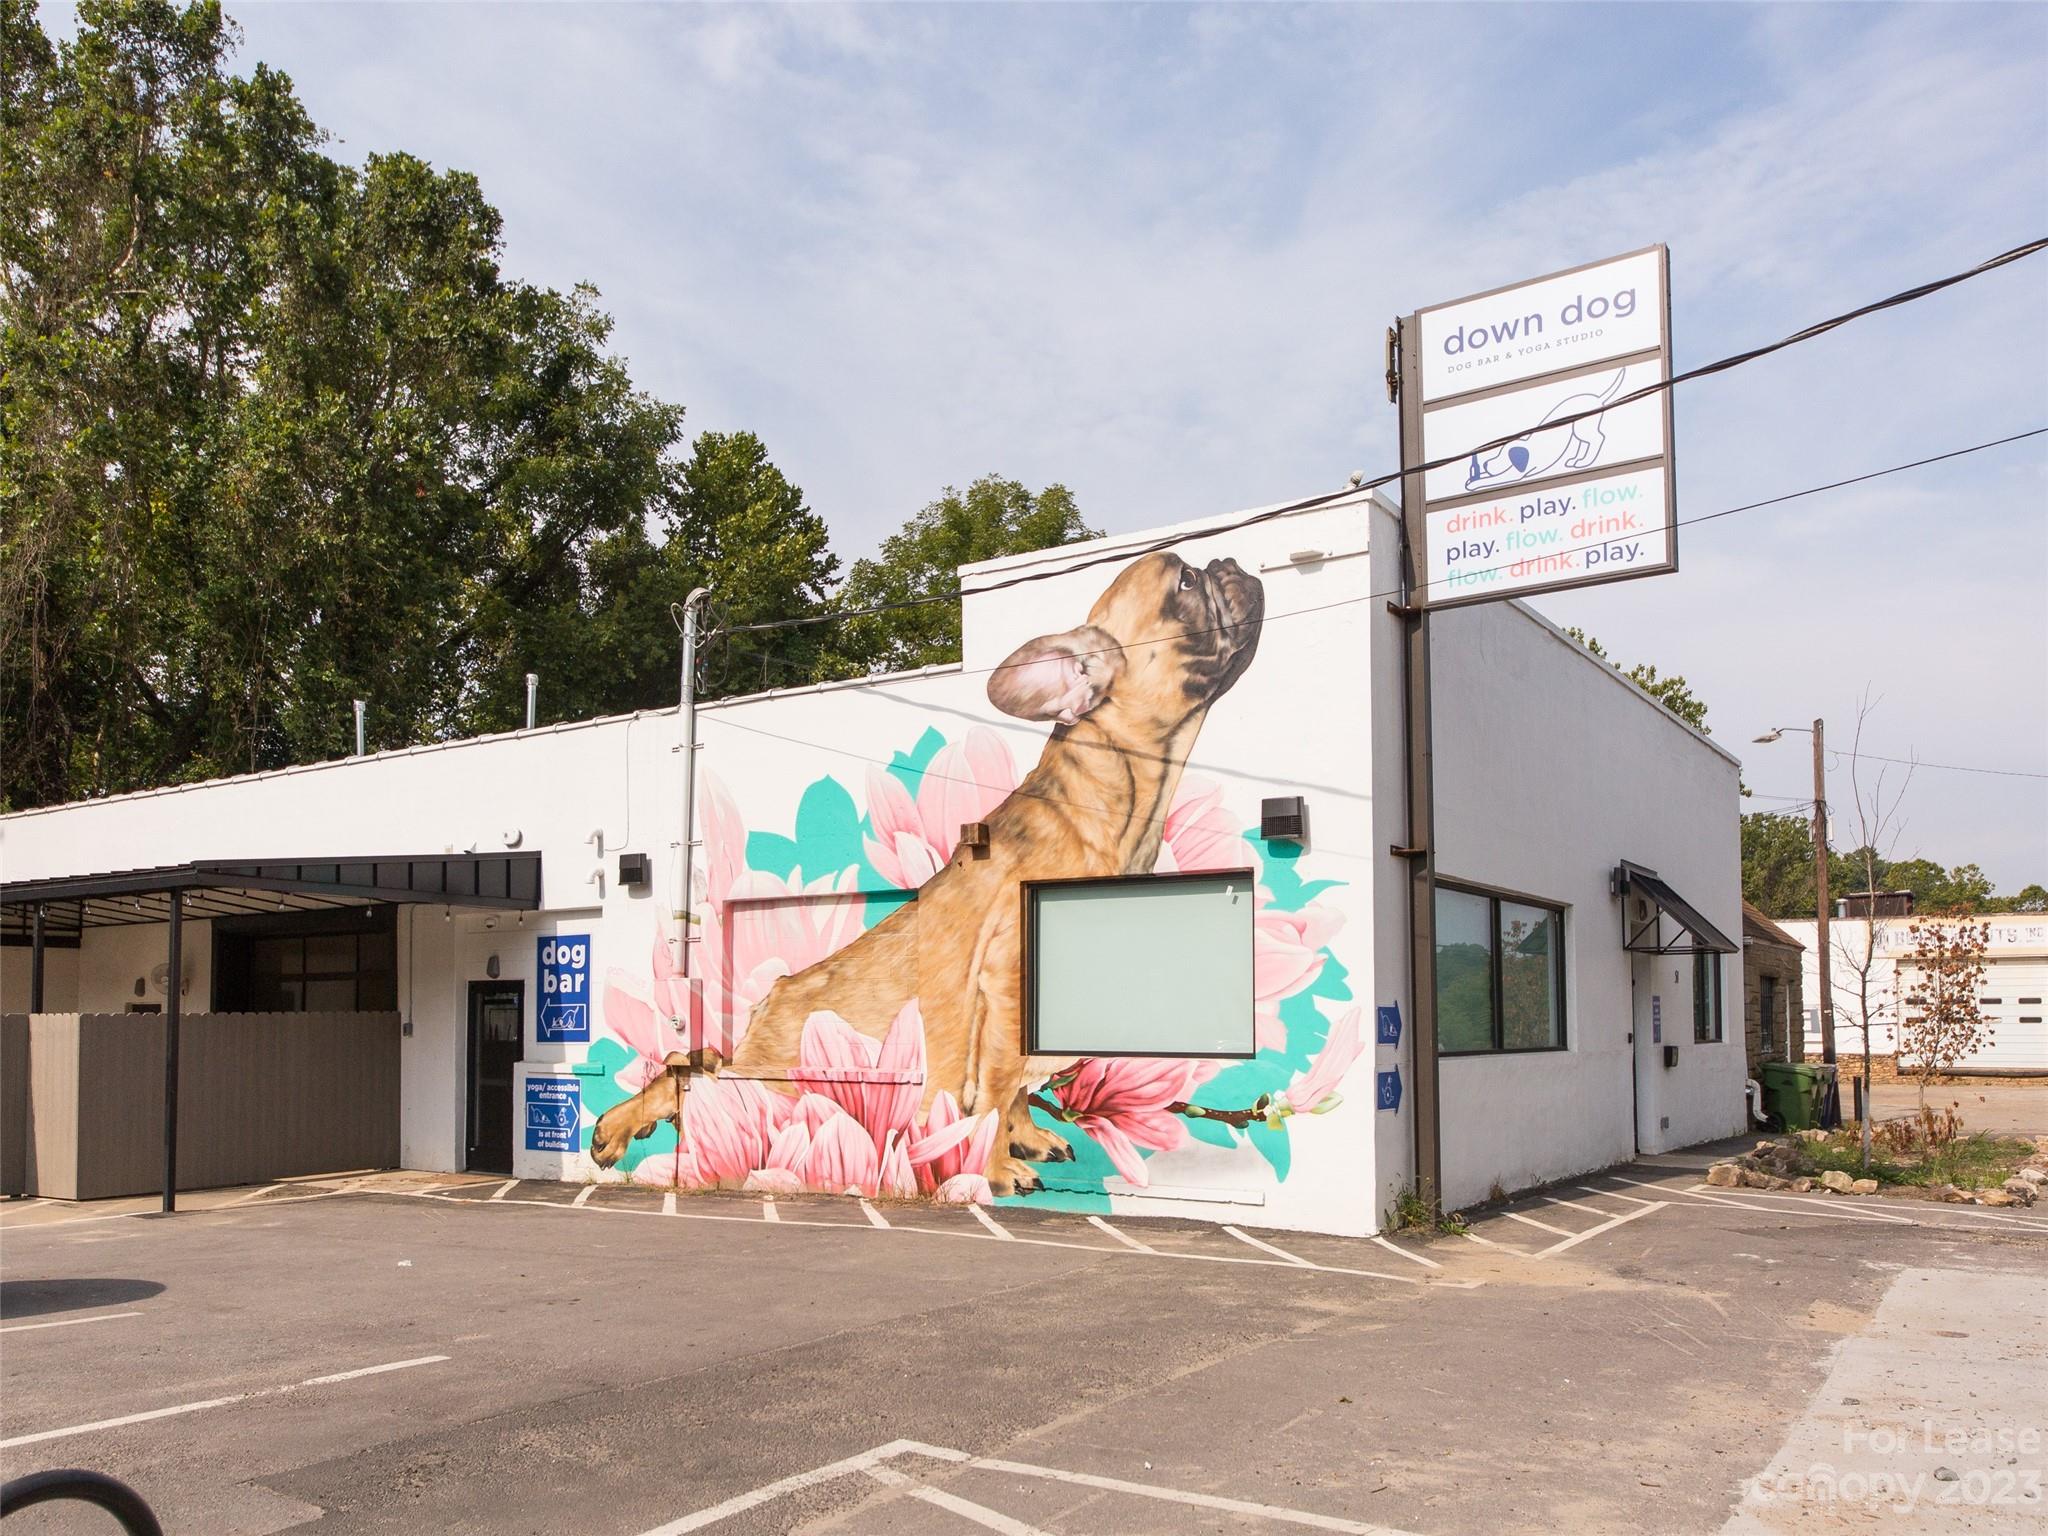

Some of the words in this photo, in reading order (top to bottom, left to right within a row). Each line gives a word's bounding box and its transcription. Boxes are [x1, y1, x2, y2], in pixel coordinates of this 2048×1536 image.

[1444, 313, 1543, 355] down
[1560, 288, 1636, 326] dog
[1447, 361, 1473, 374] DOG
[1478, 355, 1500, 367] BAR
[1505, 351, 1513, 359] &
[1518, 342, 1551, 356] YOGA
[1556, 328, 1604, 347] STUDIO
[1447, 506, 1513, 534] drink.
[1520, 496, 1576, 523] play.
[1582, 484, 1643, 508] flow.
[1447, 539, 1500, 565] play.
[1506, 527, 1563, 550] flow.
[1570, 511, 1644, 540] drink.
[1447, 568, 1503, 588] flow.
[1510, 551, 1580, 578] drink.
[1585, 542, 1645, 569] play.
[542, 940, 586, 969] dog
[543, 969, 585, 994] bar
[547, 1083, 579, 1092] accessible
[545, 1141, 569, 1150] building
[551, 1131, 567, 1139] front
